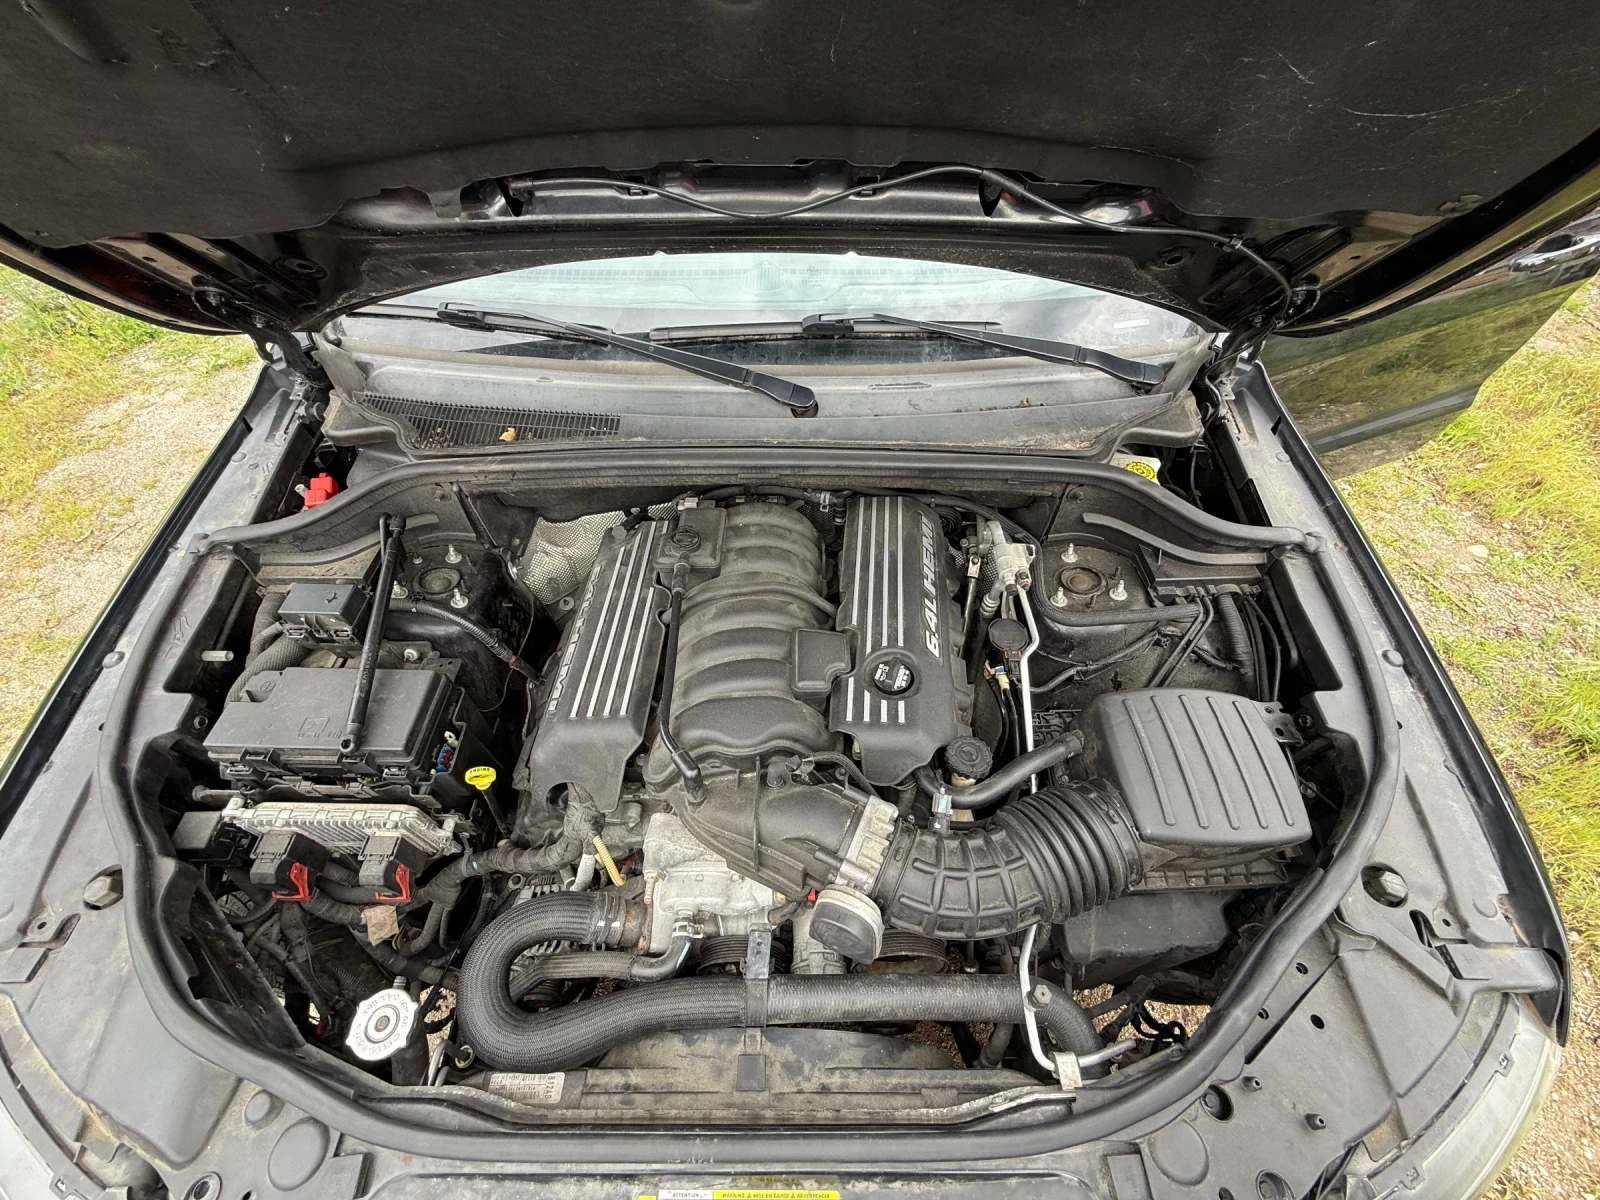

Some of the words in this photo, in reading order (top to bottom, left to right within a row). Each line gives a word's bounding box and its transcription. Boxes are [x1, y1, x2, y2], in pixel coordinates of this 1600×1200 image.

[921, 514, 936, 597] HEMI
[924, 597, 940, 658] 6.4L
[547, 617, 585, 711] HEMI
[544, 1075, 556, 1099] 812AB
